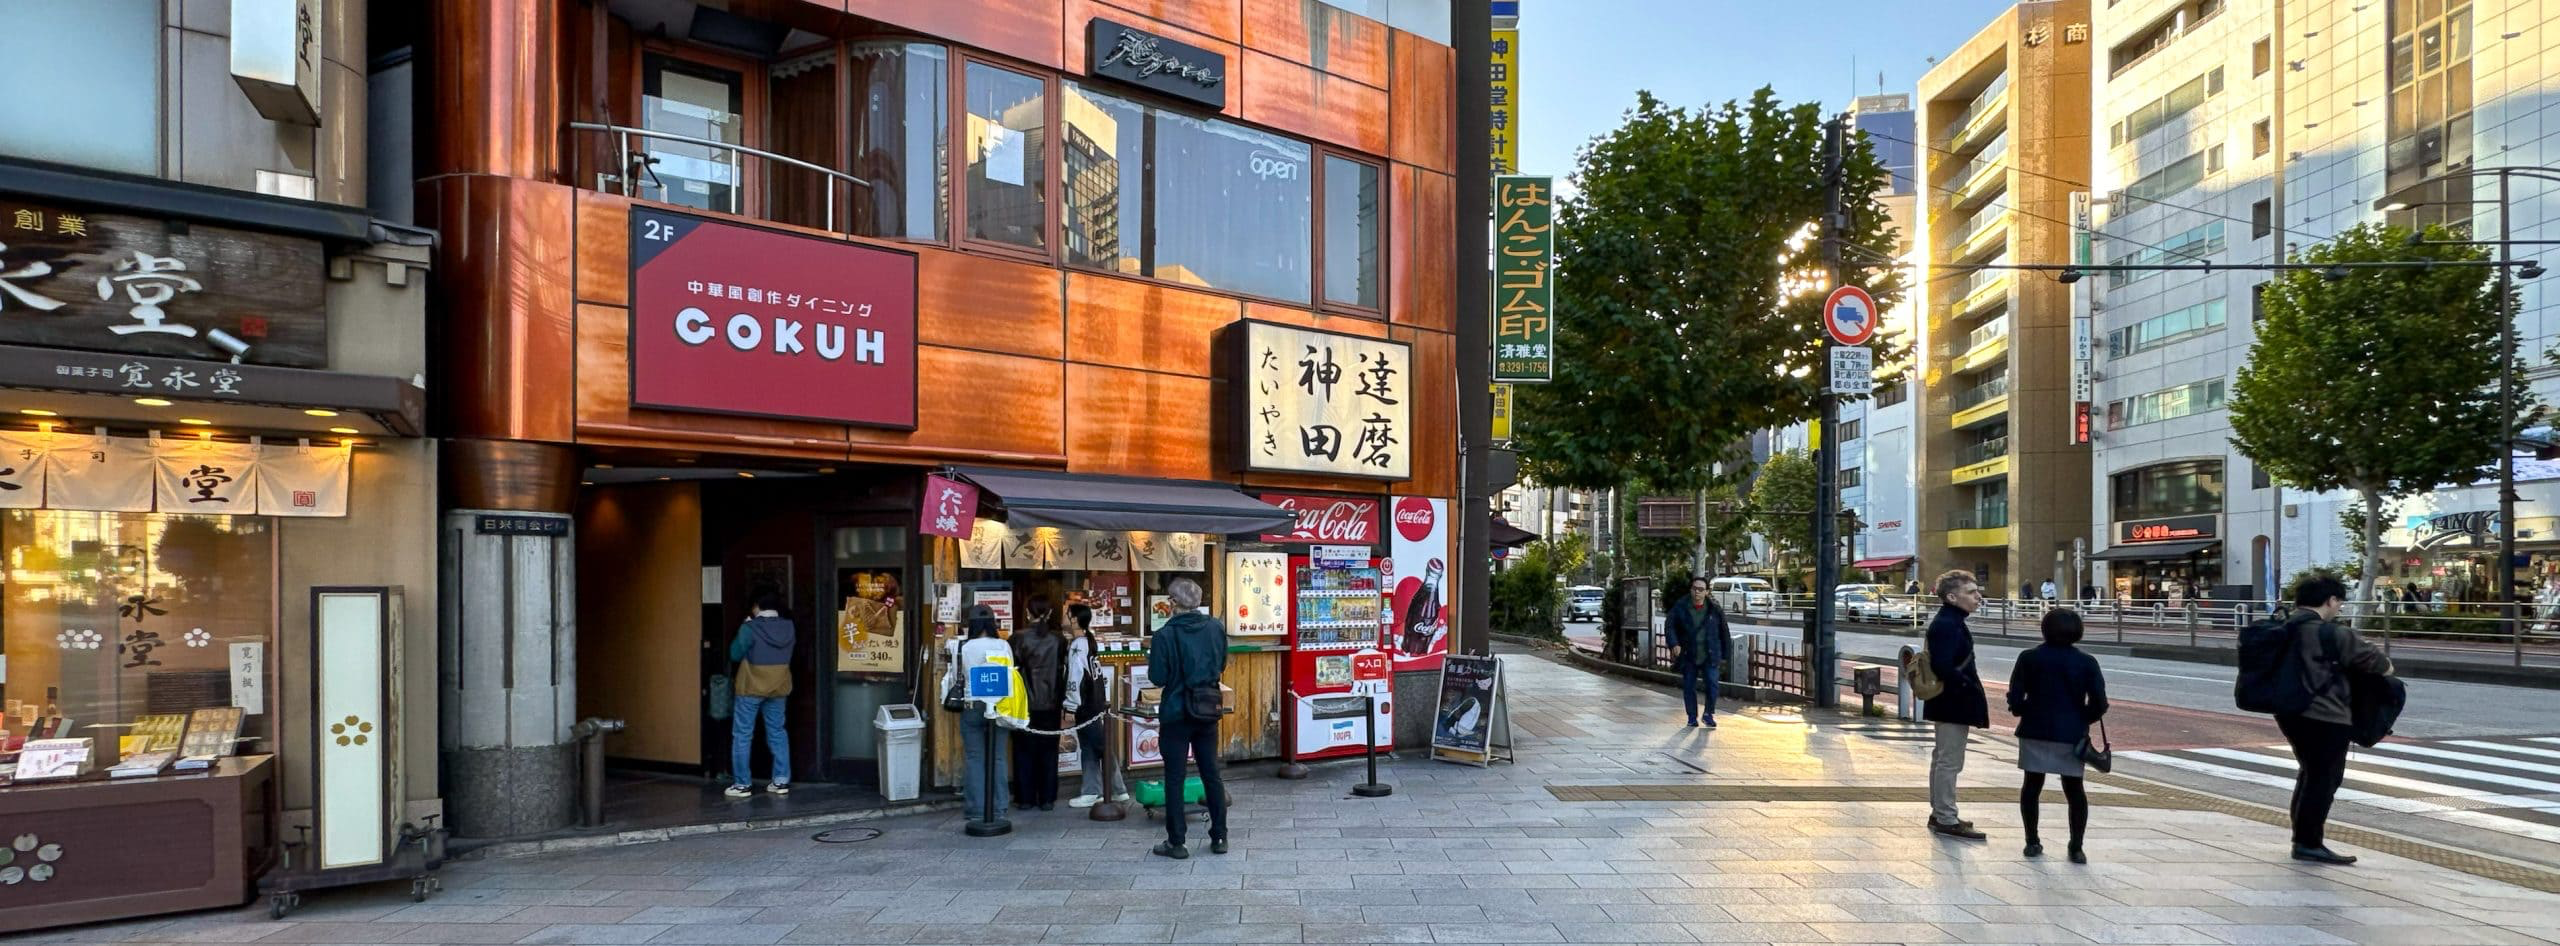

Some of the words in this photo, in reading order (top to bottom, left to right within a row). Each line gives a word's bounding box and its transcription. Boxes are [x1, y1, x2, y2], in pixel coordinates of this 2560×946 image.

[1250, 157, 1297, 181] open
[14, 208, 87, 237] 創業
[644, 219, 674, 242] 2F
[1500, 184, 1549, 340] はんこ・ゴム印
[687, 280, 873, 318] 中華風創作ダイニング
[675, 306, 885, 364] GOKUH
[1259, 345, 1281, 457] たいやき
[1298, 344, 1342, 463] 神田
[1352, 351, 1399, 469] 達磨
[1397, 508, 1432, 524] Coca-Cola
[1240, 557, 1282, 569] たいやき
[981, 672, 999, 683] 出口
[1365, 659, 1382, 669] 入口
